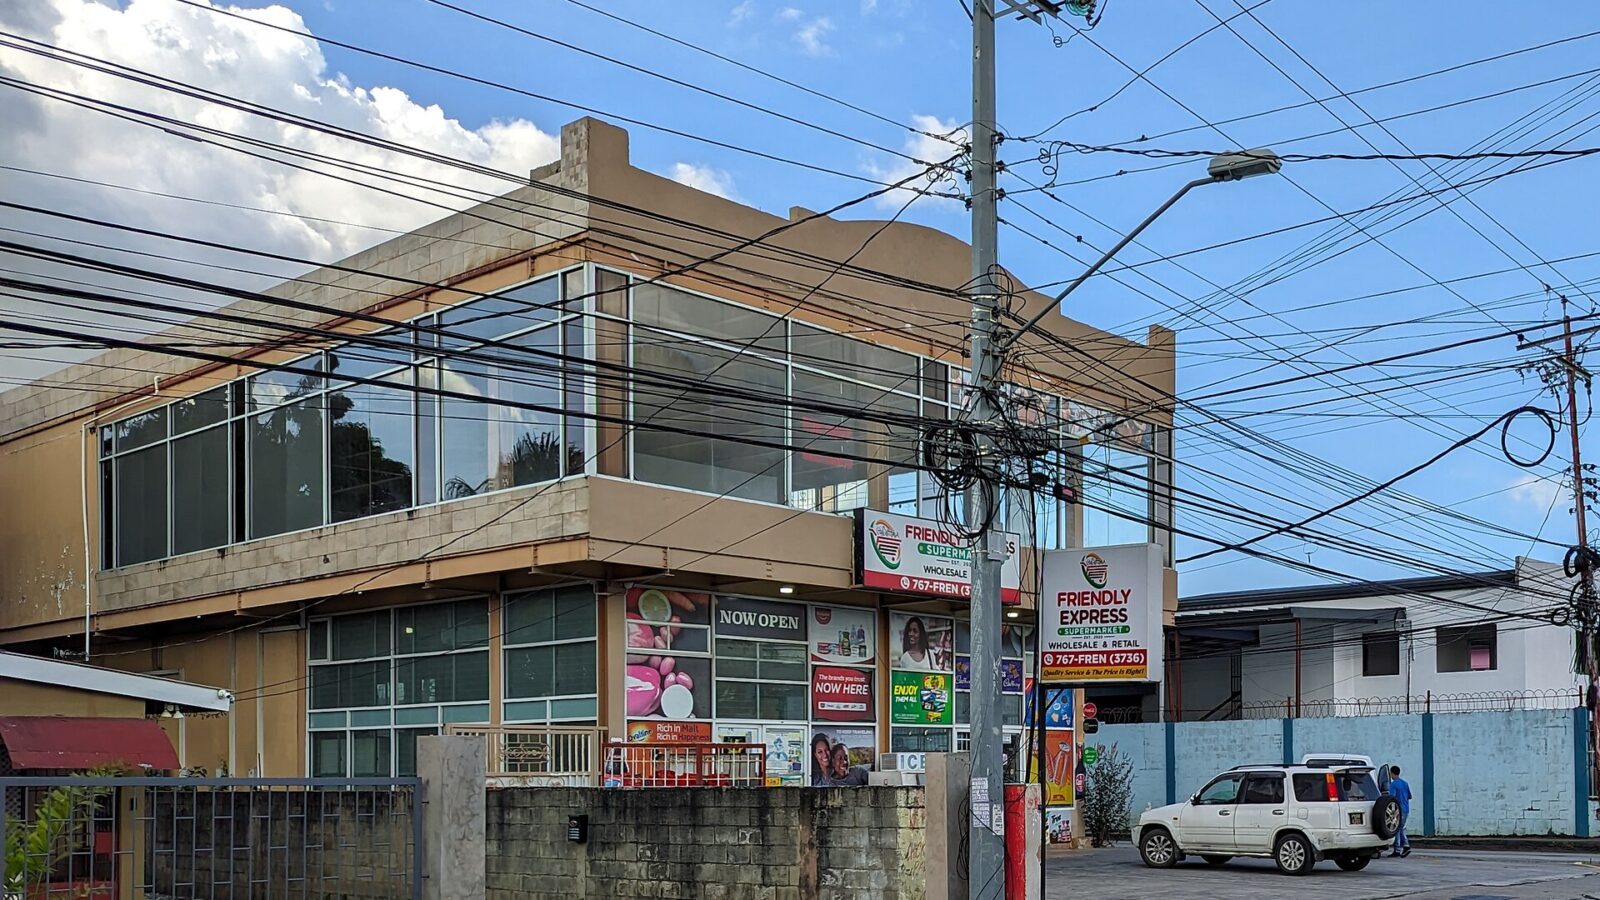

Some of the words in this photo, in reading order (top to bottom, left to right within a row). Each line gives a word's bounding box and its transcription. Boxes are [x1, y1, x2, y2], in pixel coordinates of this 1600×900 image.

[905, 524, 962, 546] FRIENDLY
[927, 545, 971, 560] SUPERMA
[923, 565, 968, 579] WHOLESALE
[912, 579, 959, 595] 767-FREN
[1057, 589, 1131, 607] FRIENDLY
[719, 609, 757, 627] NOW
[759, 613, 799, 630] OPEN
[1060, 608, 1128, 625] EXPRESS
[1064, 626, 1123, 635] SUPERMARKET
[1048, 641, 1098, 650] WHOLESALE
[1102, 640, 1108, 648] &
[1112, 639, 1140, 648] RETAIL
[1056, 654, 1107, 665] 767-FREN
[1109, 652, 1145, 665] (3736)
[1043, 668, 1064, 677] Quality
[1064, 668, 1085, 676] Service
[1125, 668, 1145, 676] Right!
[815, 682, 841, 693] NOW
[842, 684, 869, 695] HERE
[894, 685, 918, 695] ENJOY
[656, 723, 673, 733] Rich
[673, 723, 681, 733] in
[681, 724, 698, 733] Malt
[656, 733, 671, 741] Rich
[671, 733, 678, 741] in
